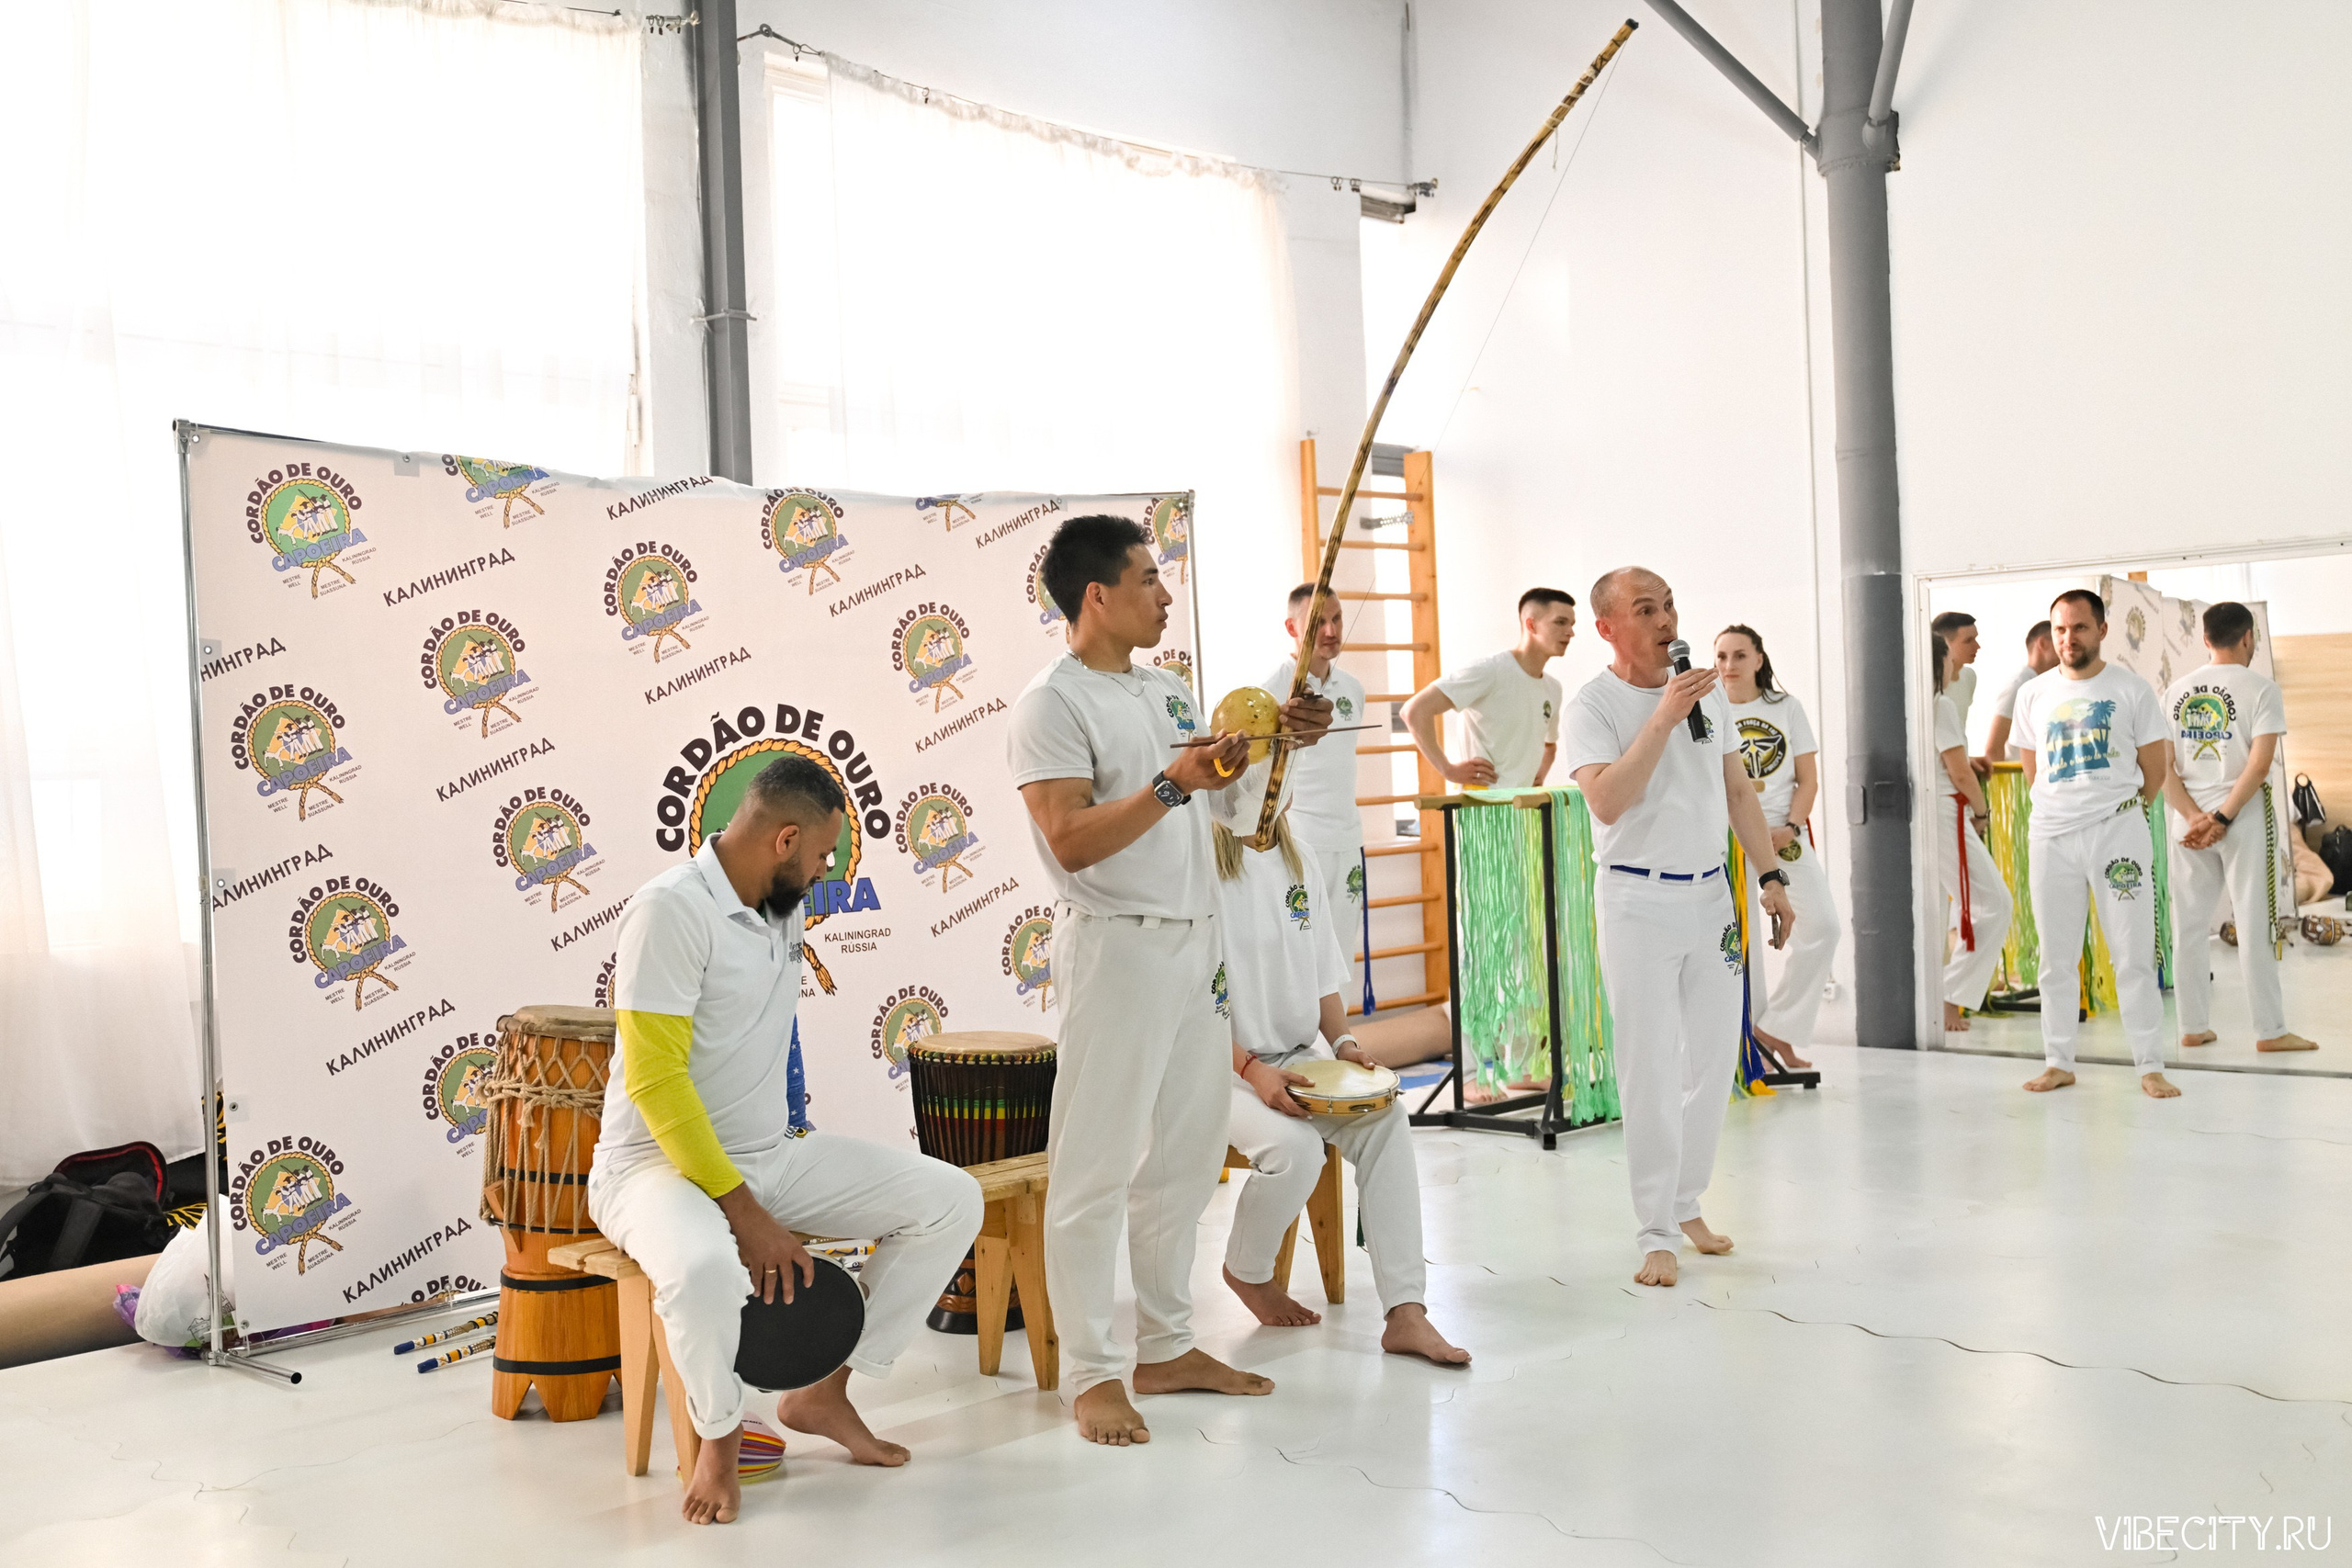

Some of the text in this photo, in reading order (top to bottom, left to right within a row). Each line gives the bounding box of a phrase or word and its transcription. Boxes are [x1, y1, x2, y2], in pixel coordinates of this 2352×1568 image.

[246, 462, 362, 544] CORDÃO DE OURO
[761, 488, 844, 549] CORDÃO OURO
[976, 500, 1060, 548] КАЛИНИНГРАД
[271, 527, 368, 572] CAPOEIRA
[383, 548, 515, 607] КАЛИНИНГРАД
[604, 541, 697, 616] CORDÃO DE OURO
[779, 534, 849, 573] CAPOEIRA
[623, 599, 702, 641] CAPOEIRA
[830, 564, 927, 618] КАЛИНИНГРАД
[421, 610, 525, 689] CORDÃO DE OURO
[891, 602, 969, 671] CORDÃO DE OURO
[444, 669, 531, 715] CAPOEIRA
[645, 647, 752, 705] КАЛИНИНГРАД
[909, 653, 973, 694] CAPOEIRA
[231, 684, 345, 770] CORDÃO DE OURO
[915, 698, 1007, 754] КАЛИНИНГРАД
[257, 746, 353, 797] CAPOEIRA
[436, 738, 556, 802] КАЛИНИНГРАД
[656, 704, 891, 852] CORDÃO DE OURO
[492, 786, 590, 867] CORDÃO DE OURO
[895, 783, 973, 853] CORDÃO DE OURO
[515, 842, 597, 891] CAPOEIRA
[914, 831, 979, 874] CAPOEIRA
[289, 876, 400, 964] CORDÃO DE OURO
[550, 895, 634, 952] КАЛИНИН
[824, 928, 891, 942] KALININGRAD
[931, 877, 1019, 938] КАЛИНИНГРАД
[314, 934, 407, 989] CAPOEIRA
[841, 942, 877, 953] RÚSSIA
[1001, 906, 1040, 976] CORDÃO DE
[595, 952, 616, 1008] ORDÃ
[326, 998, 456, 1076] КАЛИНИНГРАД
[871, 985, 949, 1059] CORDÃO DE OURO
[423, 1032, 480, 1120] CORDÃO DE
[229, 1136, 344, 1231] CORDÃO DE OURO
[255, 1192, 352, 1256] CAPOEIRA
[328, 1208, 361, 1231] KALININGRAD
[266, 1252, 288, 1268] MESTRE
[272, 1260, 287, 1271] WELL
[308, 1248, 329, 1263] MESTRE
[343, 1218, 472, 1303] КАЛИНИНГРАД
